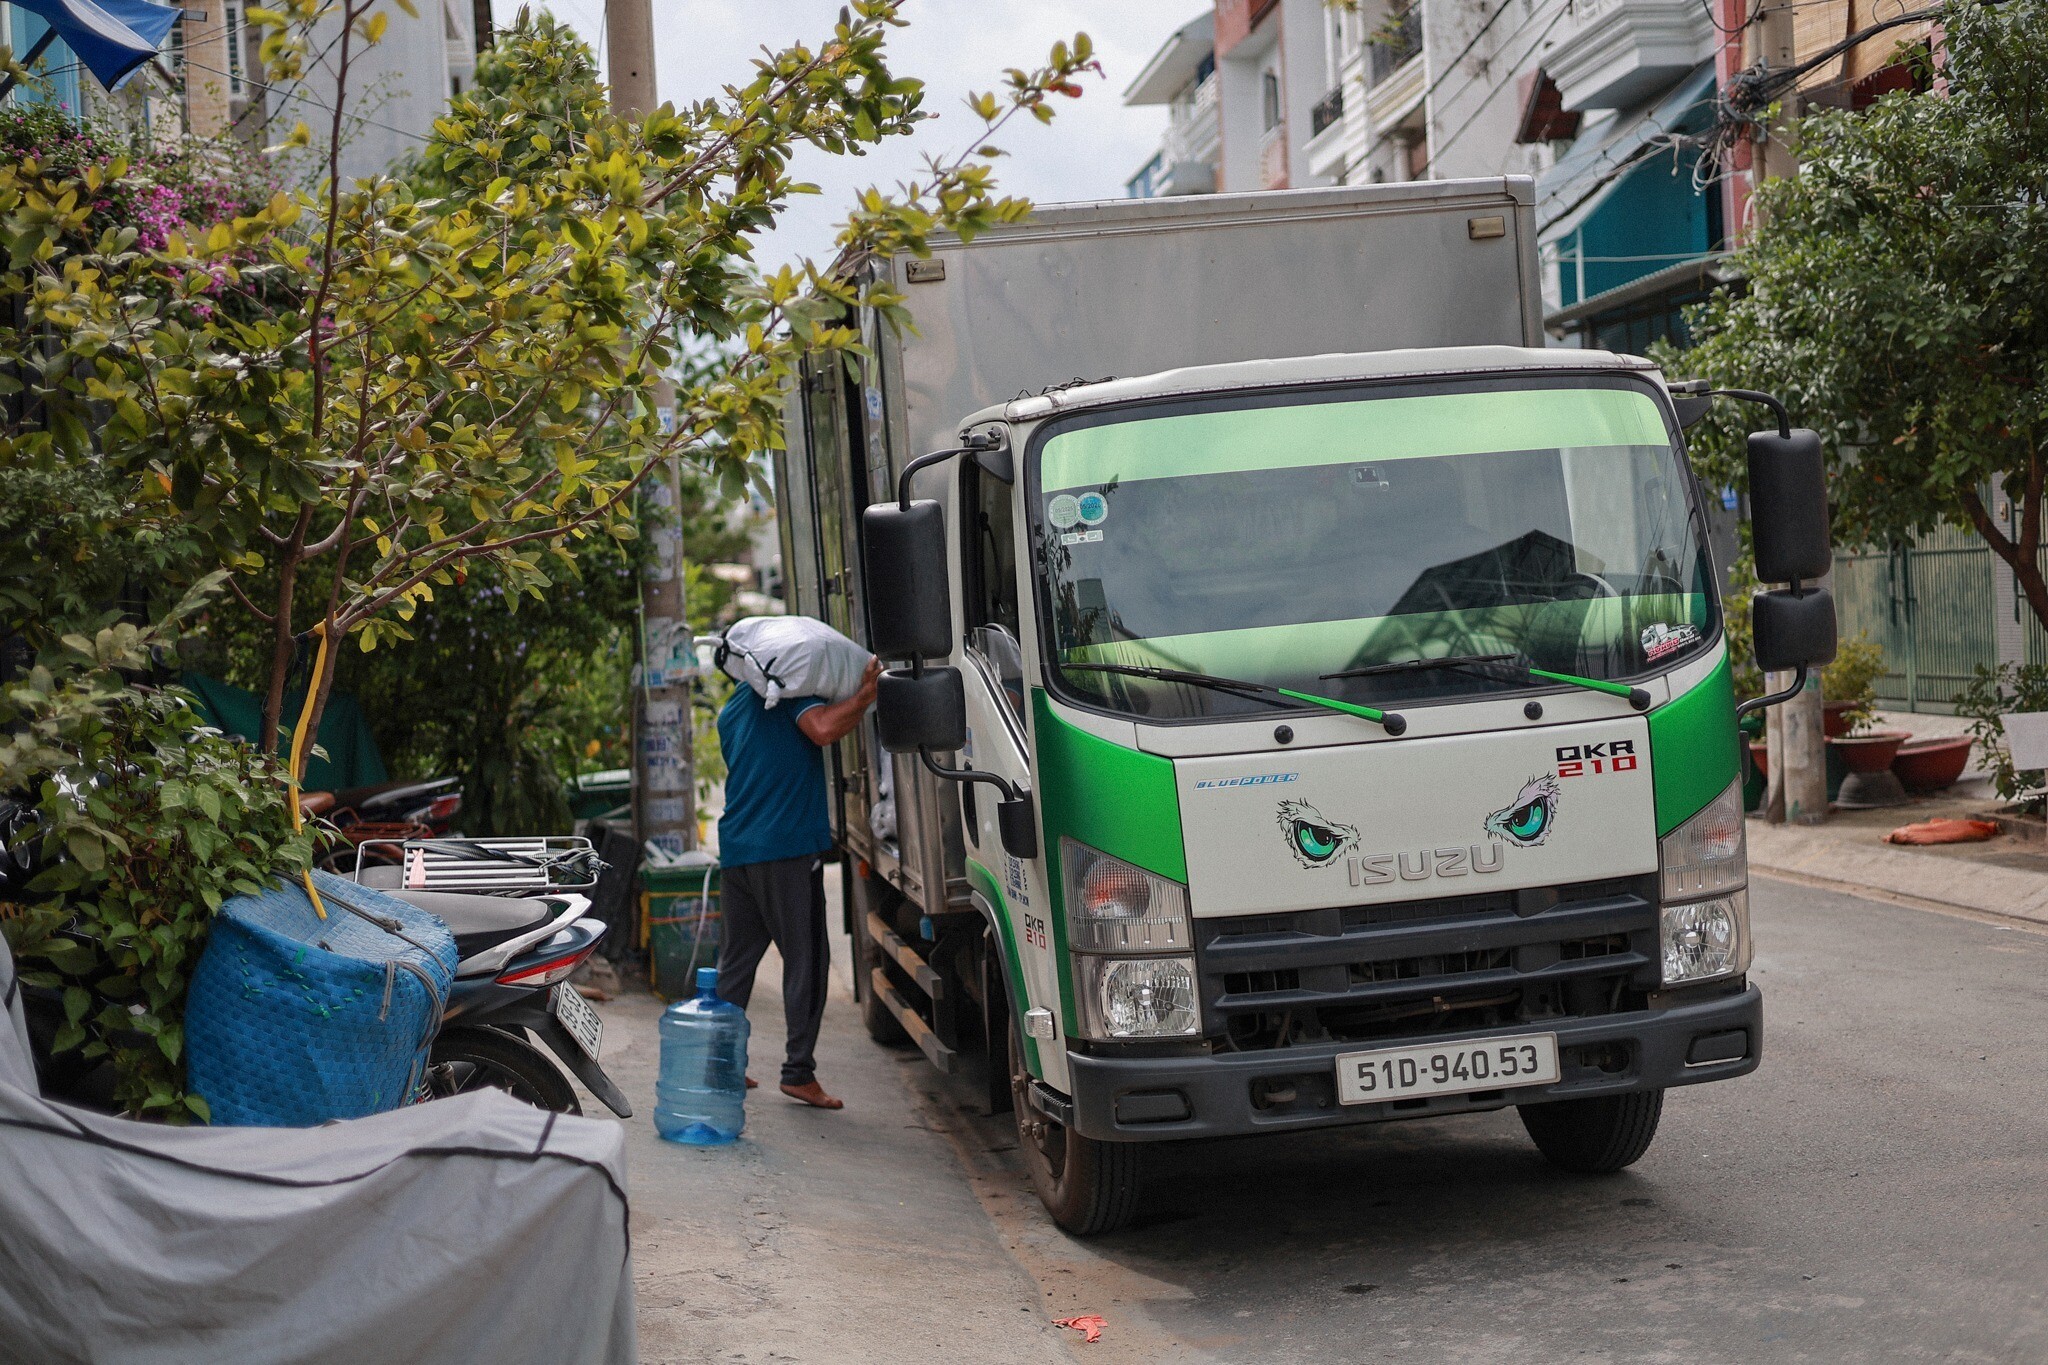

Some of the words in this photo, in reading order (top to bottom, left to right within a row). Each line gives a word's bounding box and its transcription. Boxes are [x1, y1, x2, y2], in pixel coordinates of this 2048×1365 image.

[1556, 740, 1635, 761] QKR
[1558, 755, 1637, 778] 210
[1196, 773, 1299, 789] BLUEPOWER
[1348, 843, 1504, 886] ISUZU
[1024, 913, 1045, 934] QKR
[1026, 928, 1046, 950] 210
[1357, 1045, 1538, 1092] 51D-940.53
